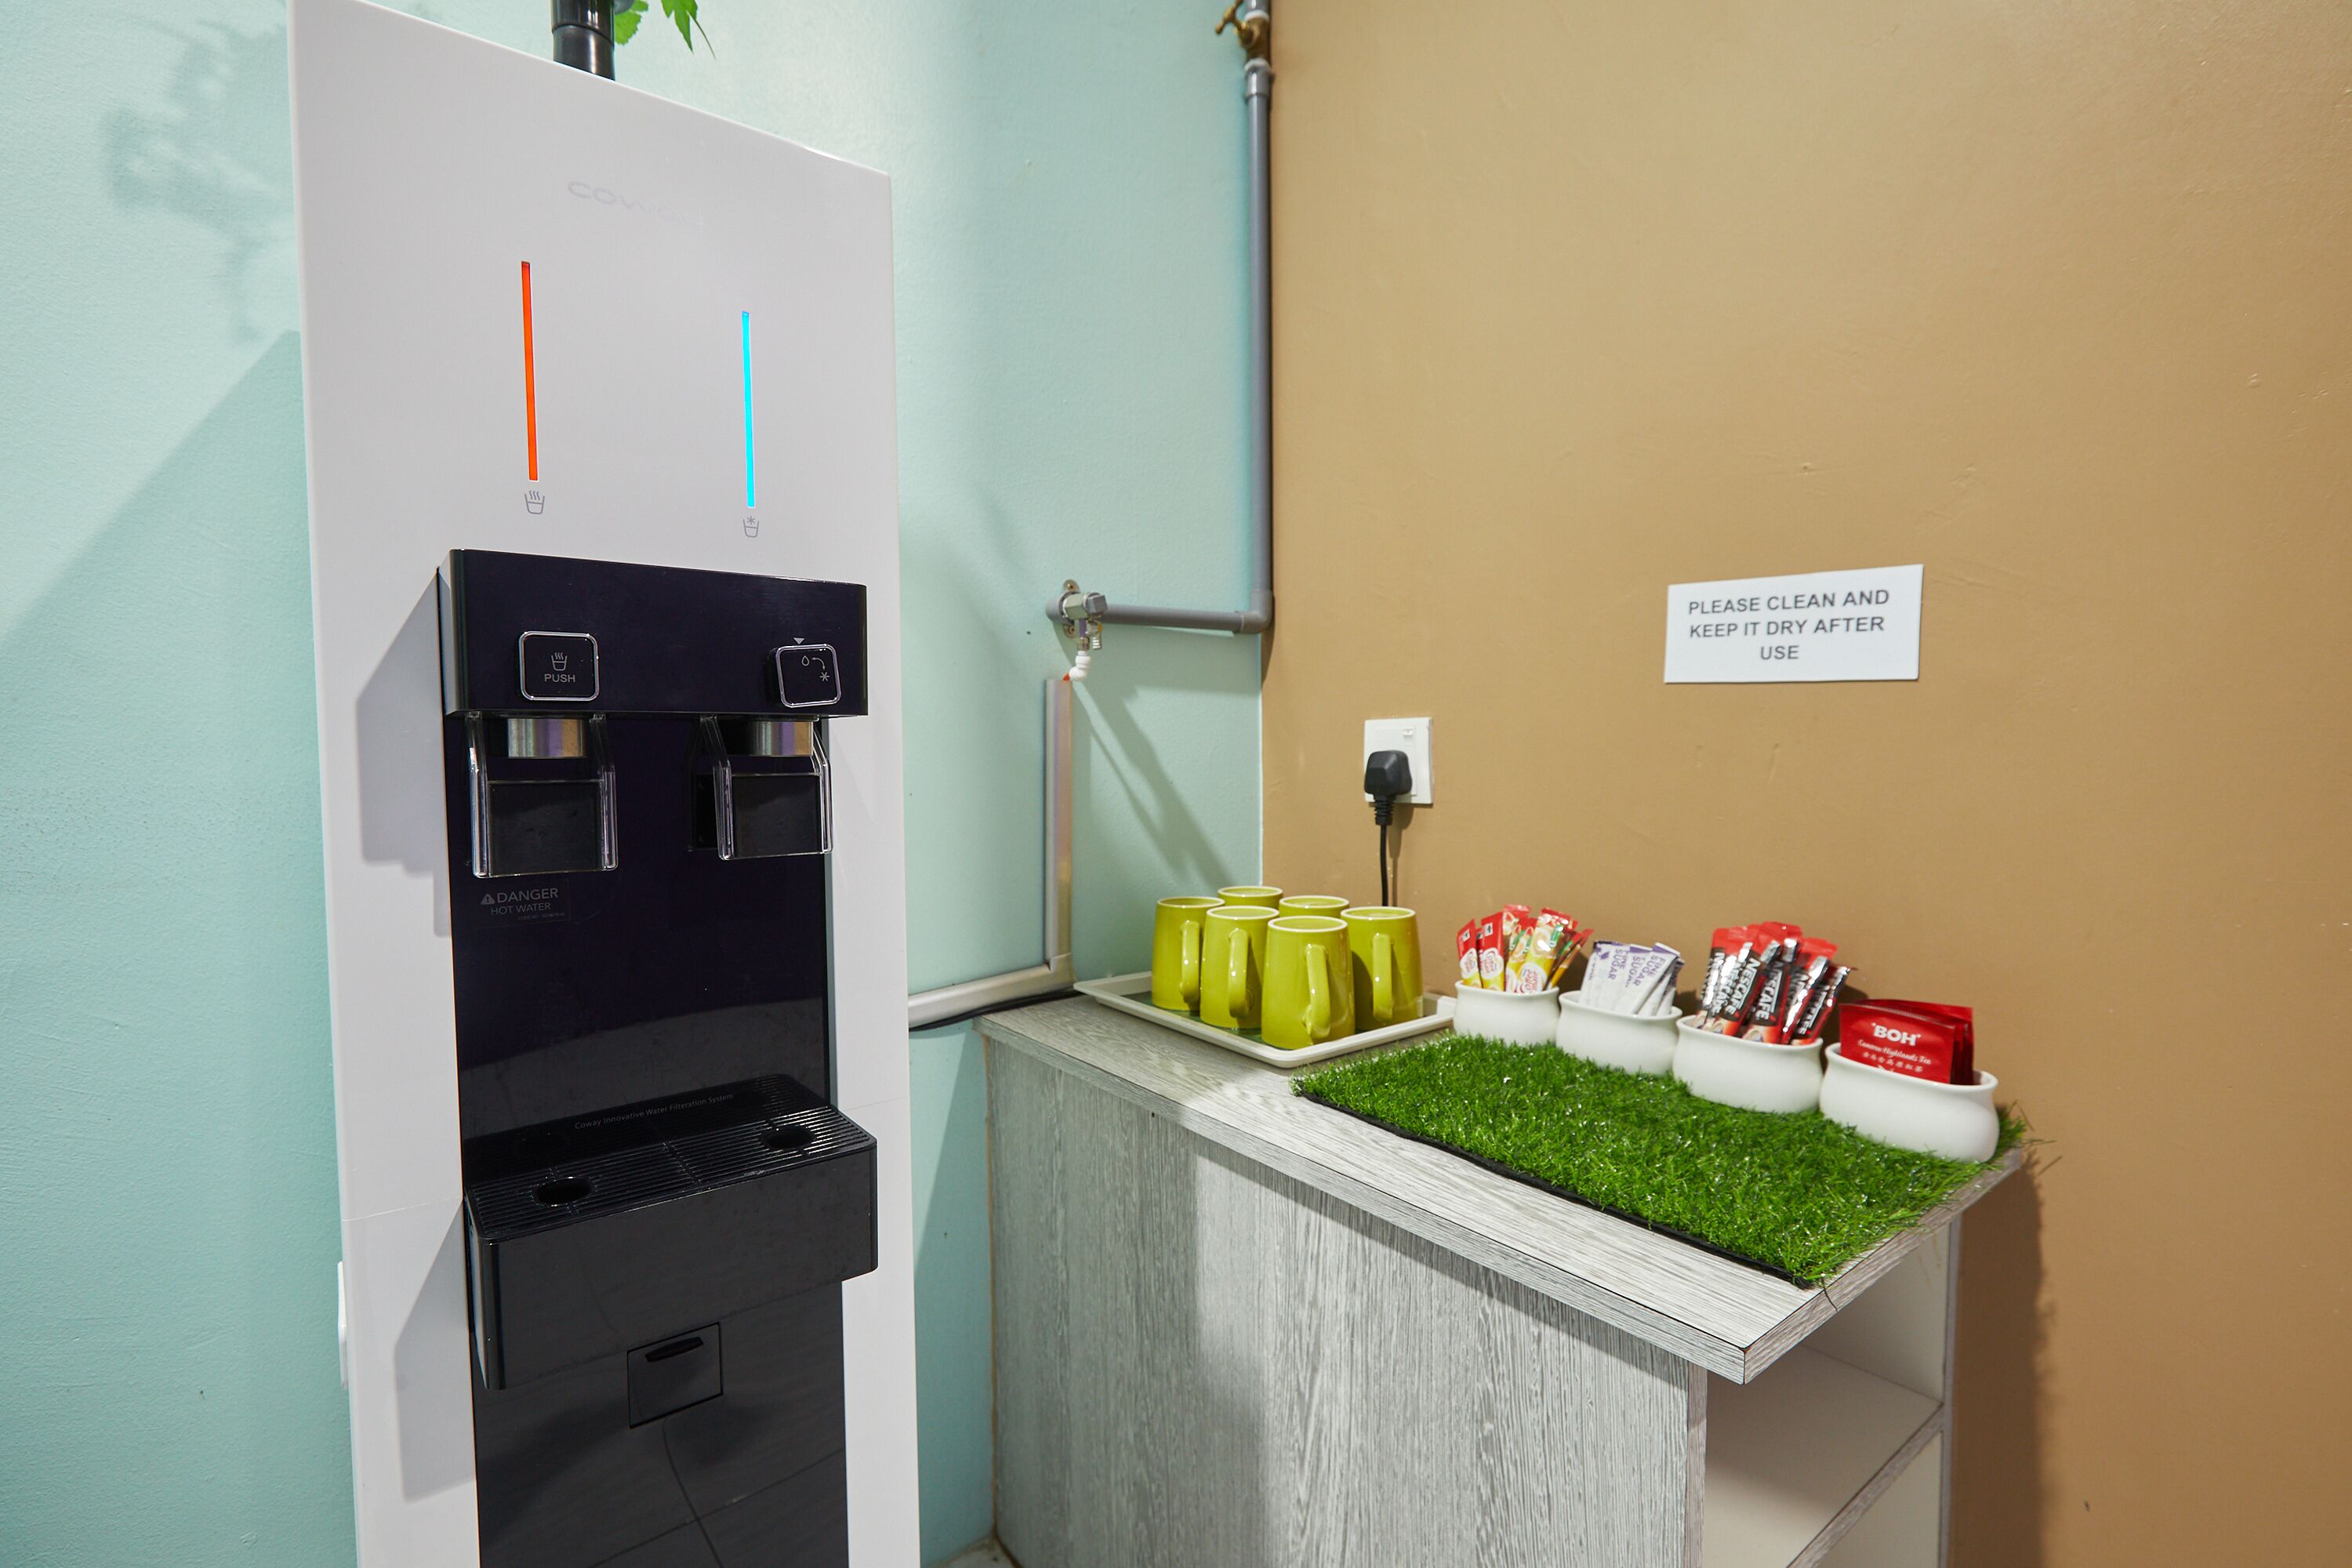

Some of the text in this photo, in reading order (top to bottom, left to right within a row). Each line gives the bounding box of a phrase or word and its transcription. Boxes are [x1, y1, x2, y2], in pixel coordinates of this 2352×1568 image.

[1689, 590, 1889, 615] PLEASE CLEAN AND
[1690, 616, 1885, 637] KEEP IT DRY AFTER
[1760, 645, 1799, 660] USE
[544, 673, 575, 683] PUSH
[497, 887, 558, 903] DANGER
[491, 902, 551, 916] HOT WATER
[1608, 948, 1621, 980] SUGAR
[1625, 956, 1641, 988] SUGA
[1633, 955, 1656, 986] SUGAR
[1648, 957, 1666, 978] FINE
[575, 1094, 734, 1130] Coway Innovative Water Filteration System
